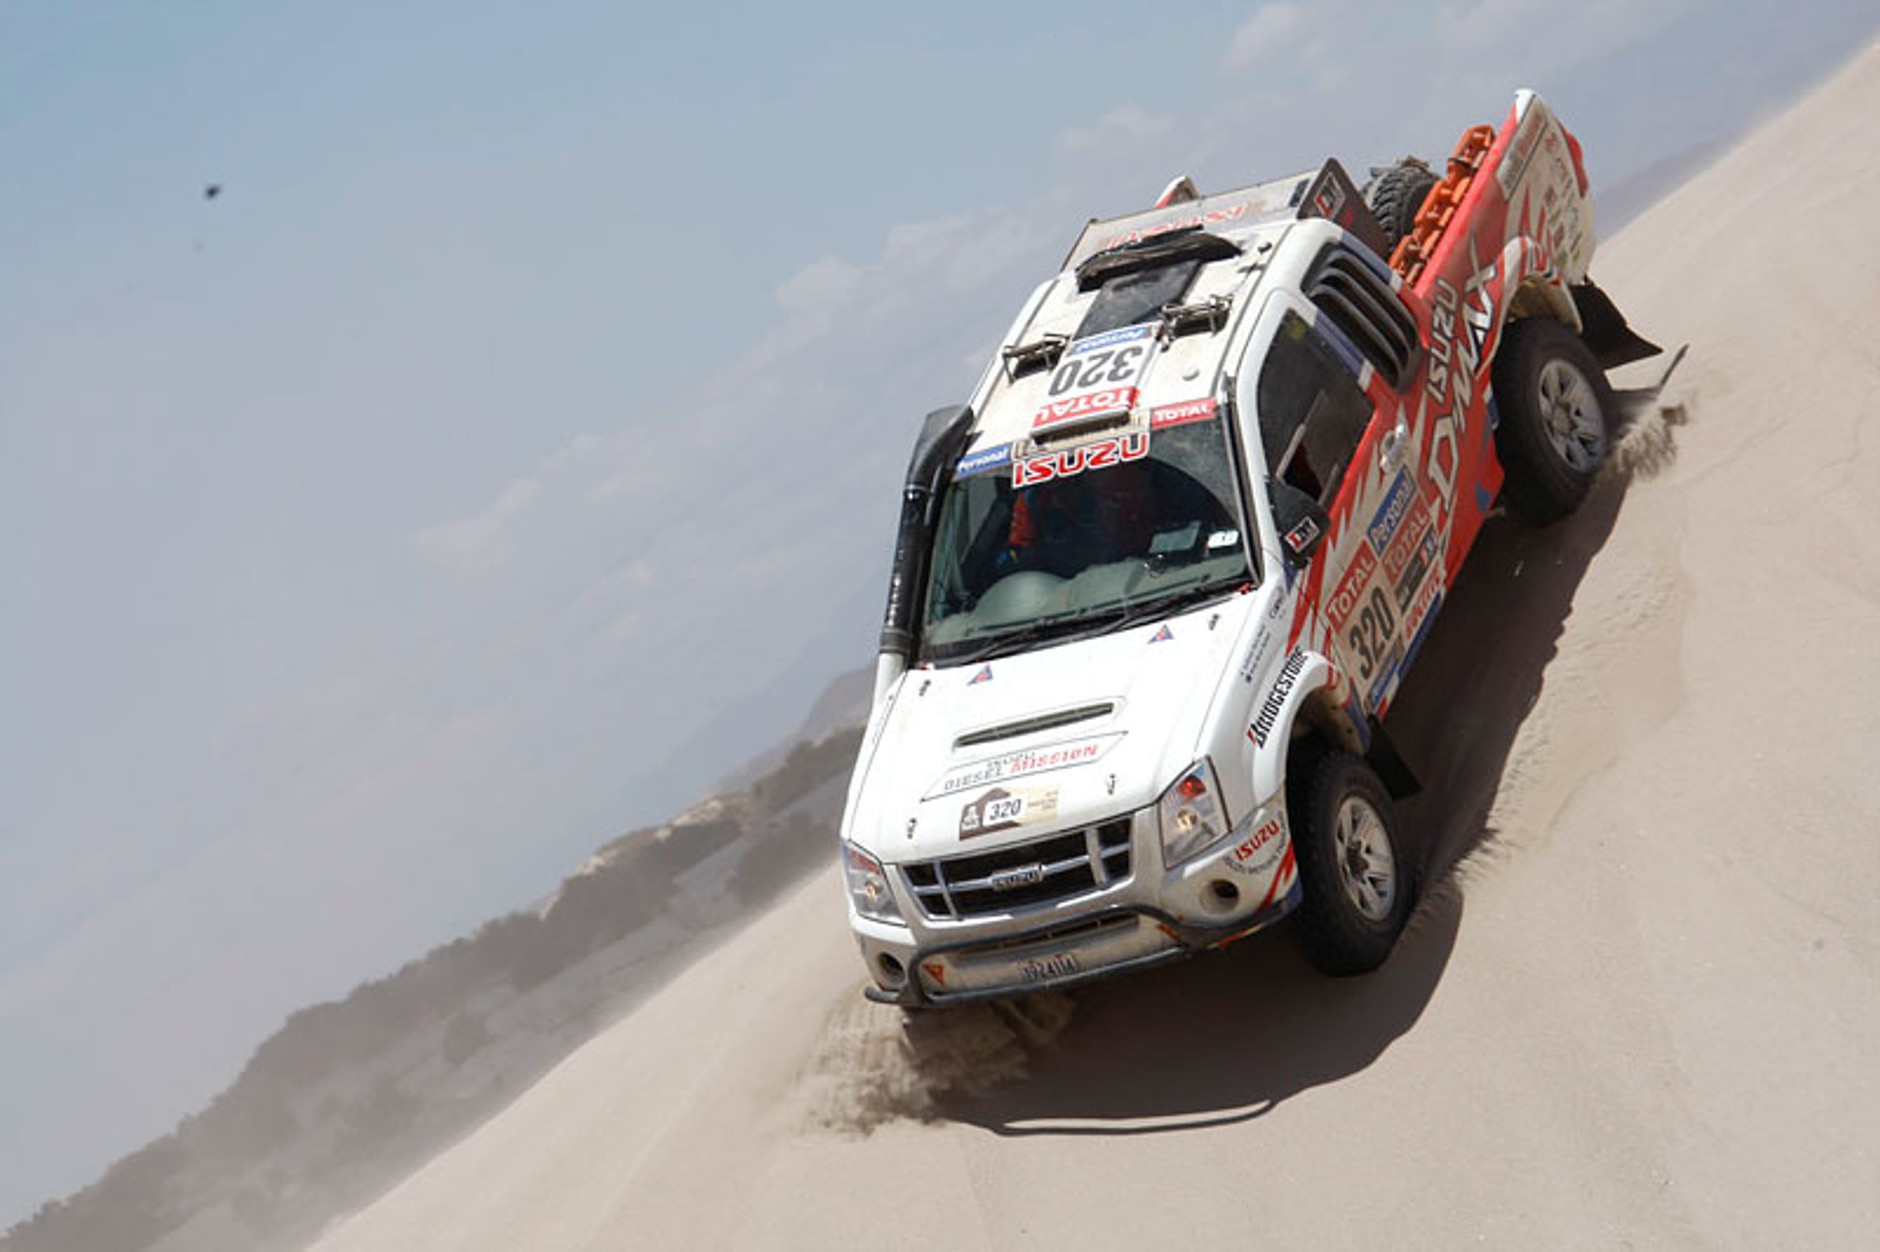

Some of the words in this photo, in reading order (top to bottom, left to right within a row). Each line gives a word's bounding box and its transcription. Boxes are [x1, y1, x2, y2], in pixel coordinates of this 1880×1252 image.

[1426, 278, 1459, 402] ISUZU
[1049, 345, 1144, 397] 320
[1038, 388, 1134, 422] TOTAL
[1155, 402, 1210, 423] TOTAL
[1013, 433, 1149, 489] ISUZU
[1384, 508, 1429, 577] TOTAL
[1327, 555, 1375, 628] TOTAL
[1349, 586, 1395, 681] 320
[1247, 645, 1309, 749] BRIDGESTONE
[943, 765, 1005, 791] DIESEL
[1009, 744, 1100, 774] MISSION
[988, 798, 1023, 822] 320
[1234, 819, 1280, 861] ISUZU
